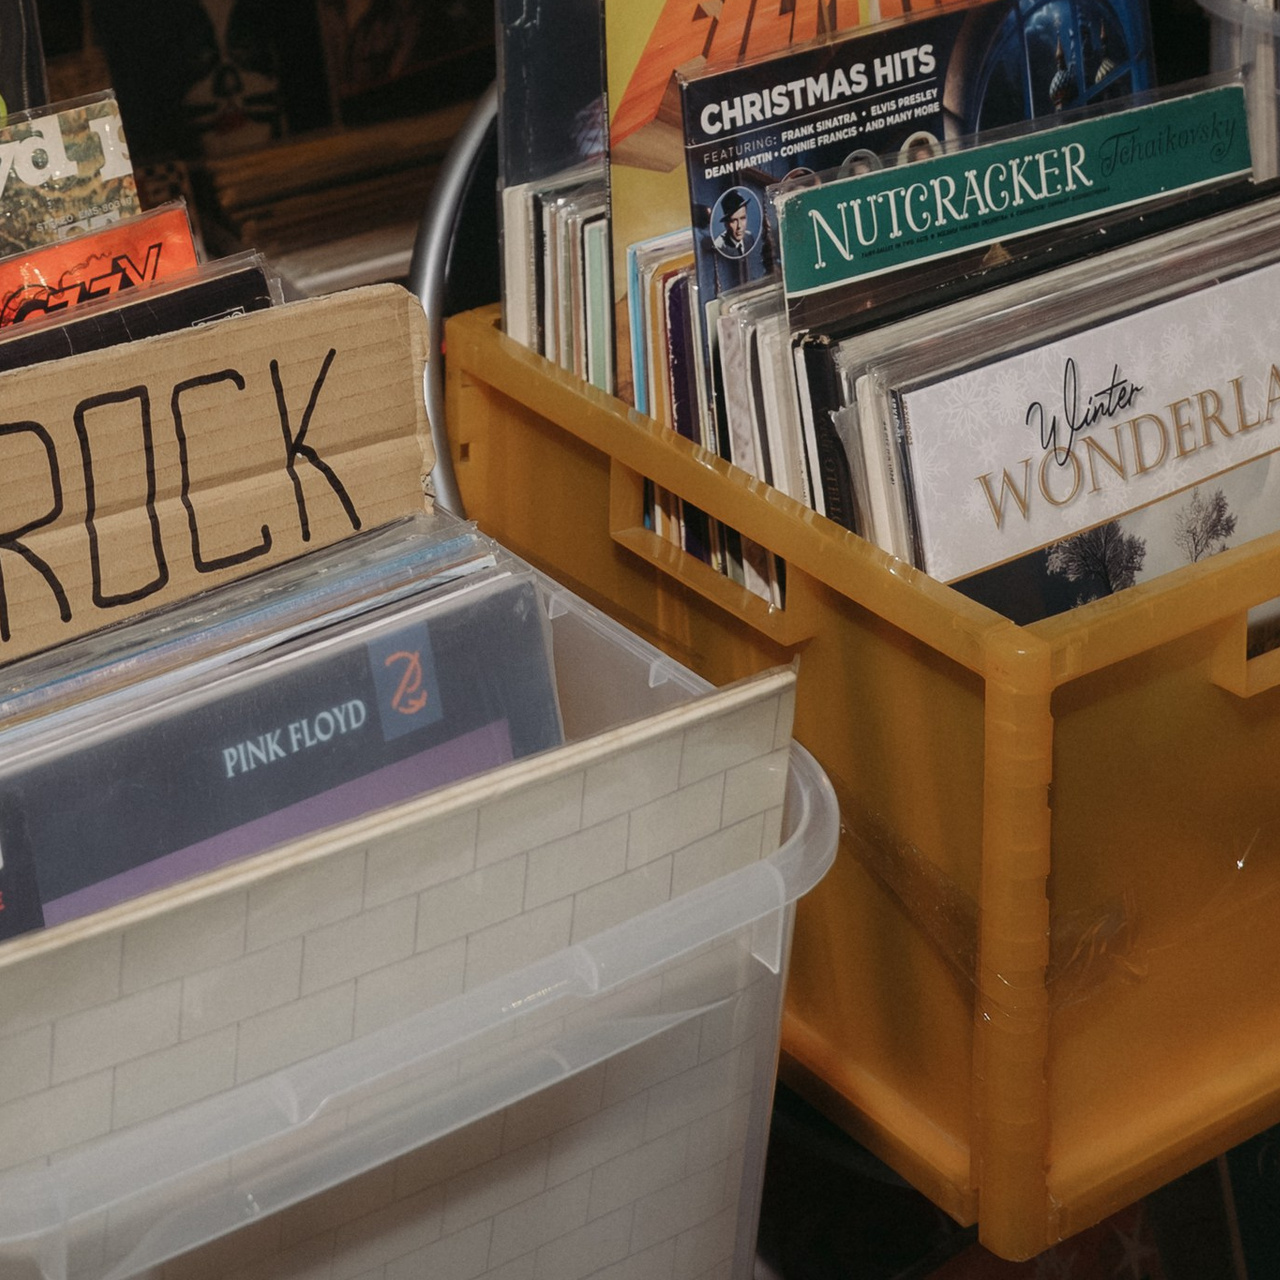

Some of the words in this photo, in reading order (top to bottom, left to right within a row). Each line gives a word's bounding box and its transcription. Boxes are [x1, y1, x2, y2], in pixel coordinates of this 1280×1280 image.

[700, 63, 868, 135] CHRISTMAS
[874, 44, 936, 87] HITS
[703, 136, 777, 165] FEATURING:
[781, 124, 814, 143] FRANK
[816, 112, 857, 132] SINATRA
[871, 100, 896, 117] ELVIS
[898, 88, 938, 107] PRESLEY
[705, 163, 734, 179] DEAN
[736, 151, 772, 172] MARTIN
[780, 138, 816, 158] CONNIE
[818, 127, 857, 147] FRANCIS
[865, 117, 884, 132] AND
[886, 110, 912, 127] MANY
[914, 102, 940, 120] MORE
[808, 142, 1093, 269] NUTCRACKER
[1098, 112, 1237, 178] Tchaikovsky
[975, 364, 1280, 530] WONDERLA
[1026, 358, 1143, 467] Winter
[223, 729, 286, 778] PINK
[288, 699, 366, 752] FLOYD
